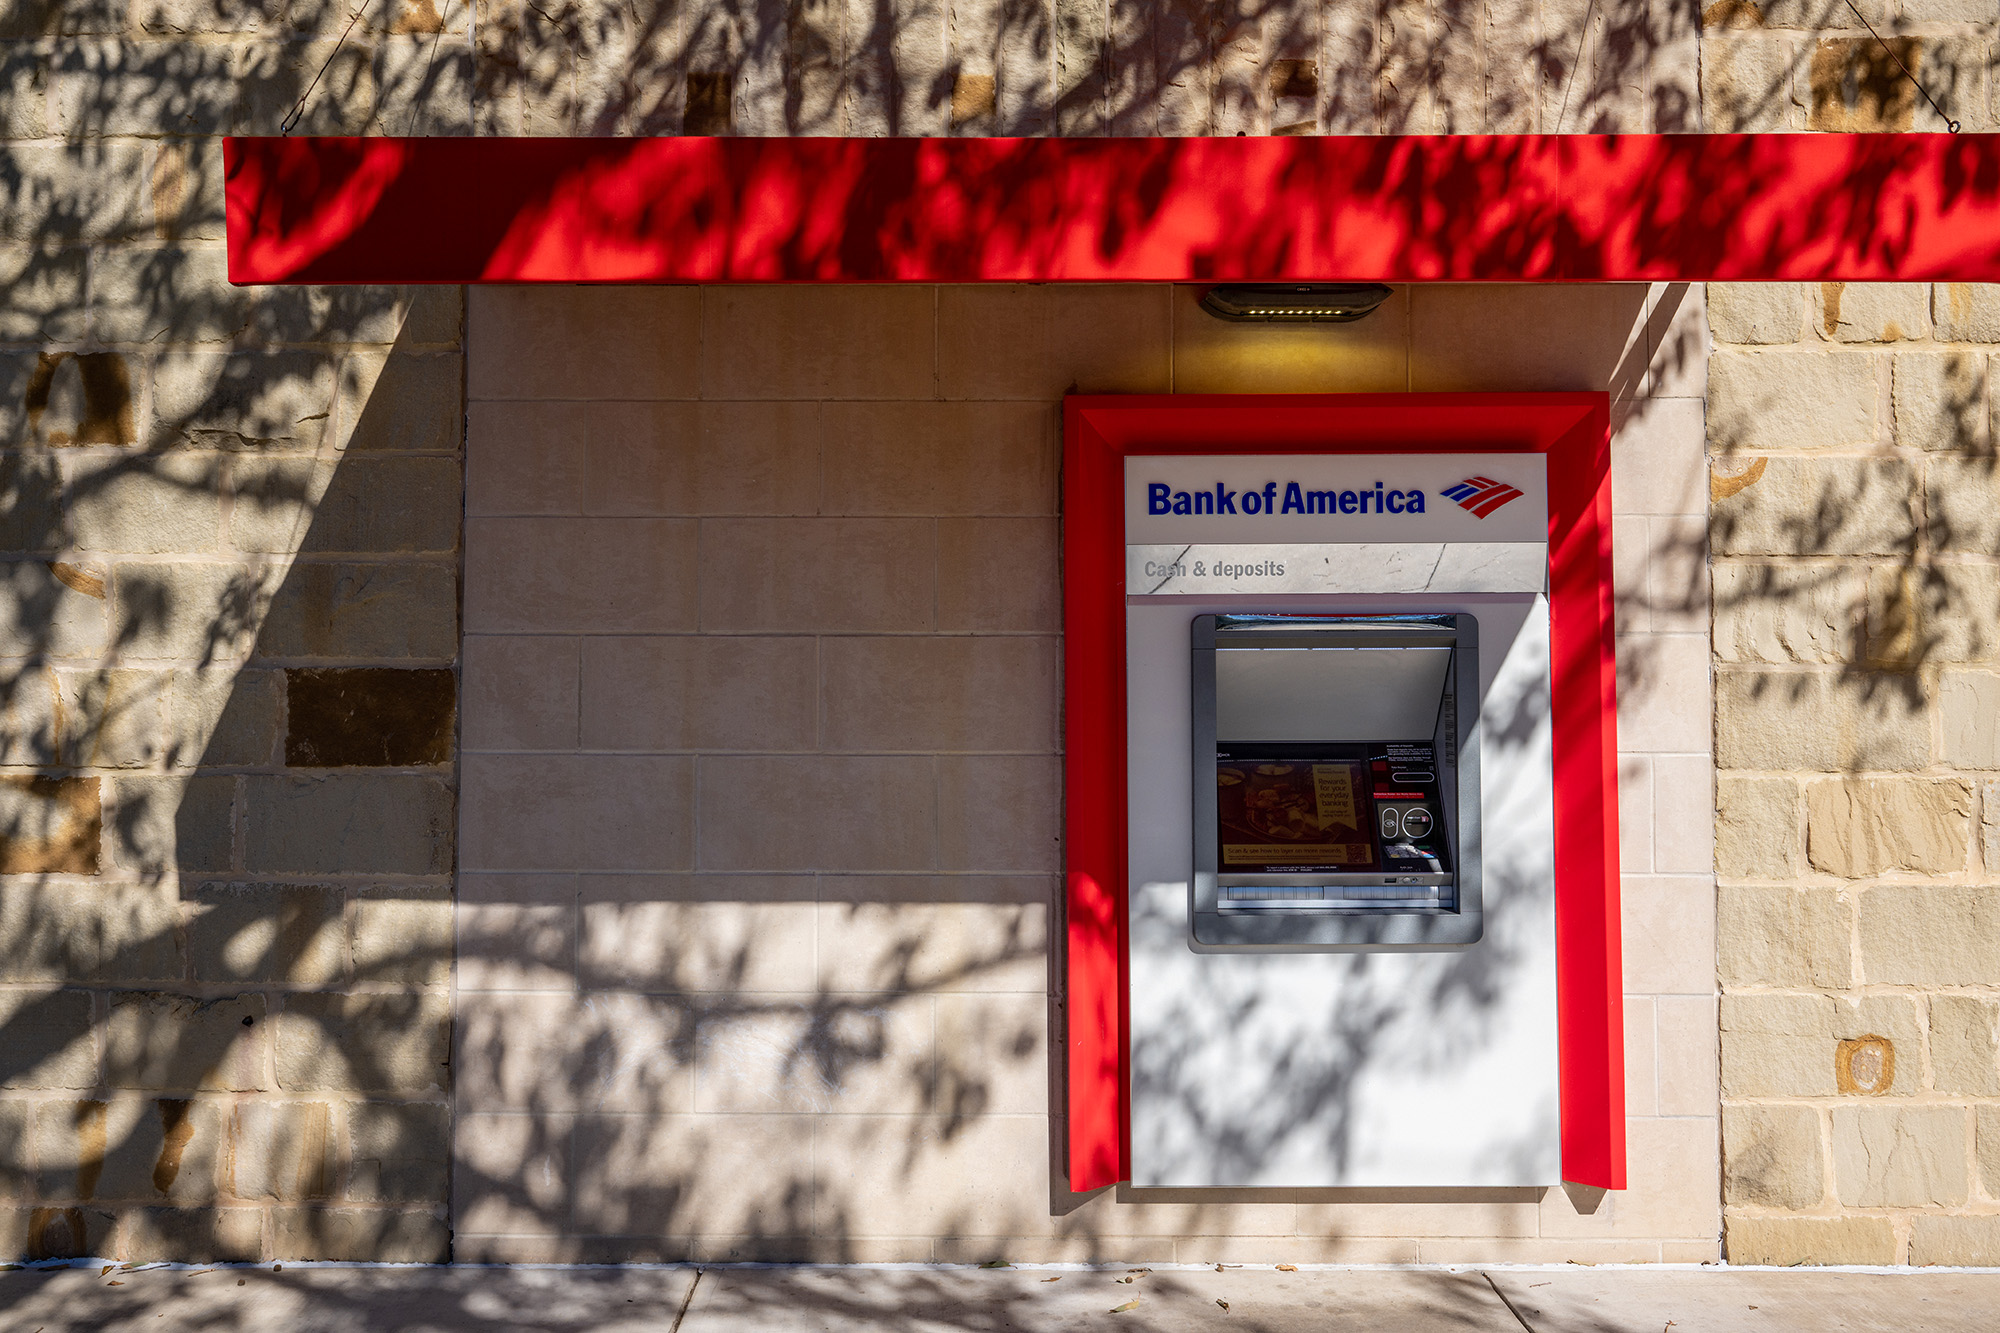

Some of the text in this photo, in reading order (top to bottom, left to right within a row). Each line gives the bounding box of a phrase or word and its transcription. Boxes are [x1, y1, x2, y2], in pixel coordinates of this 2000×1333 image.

[1148, 481, 1426, 516] Bank of America
[1145, 560, 1285, 580] Cash & deposits
